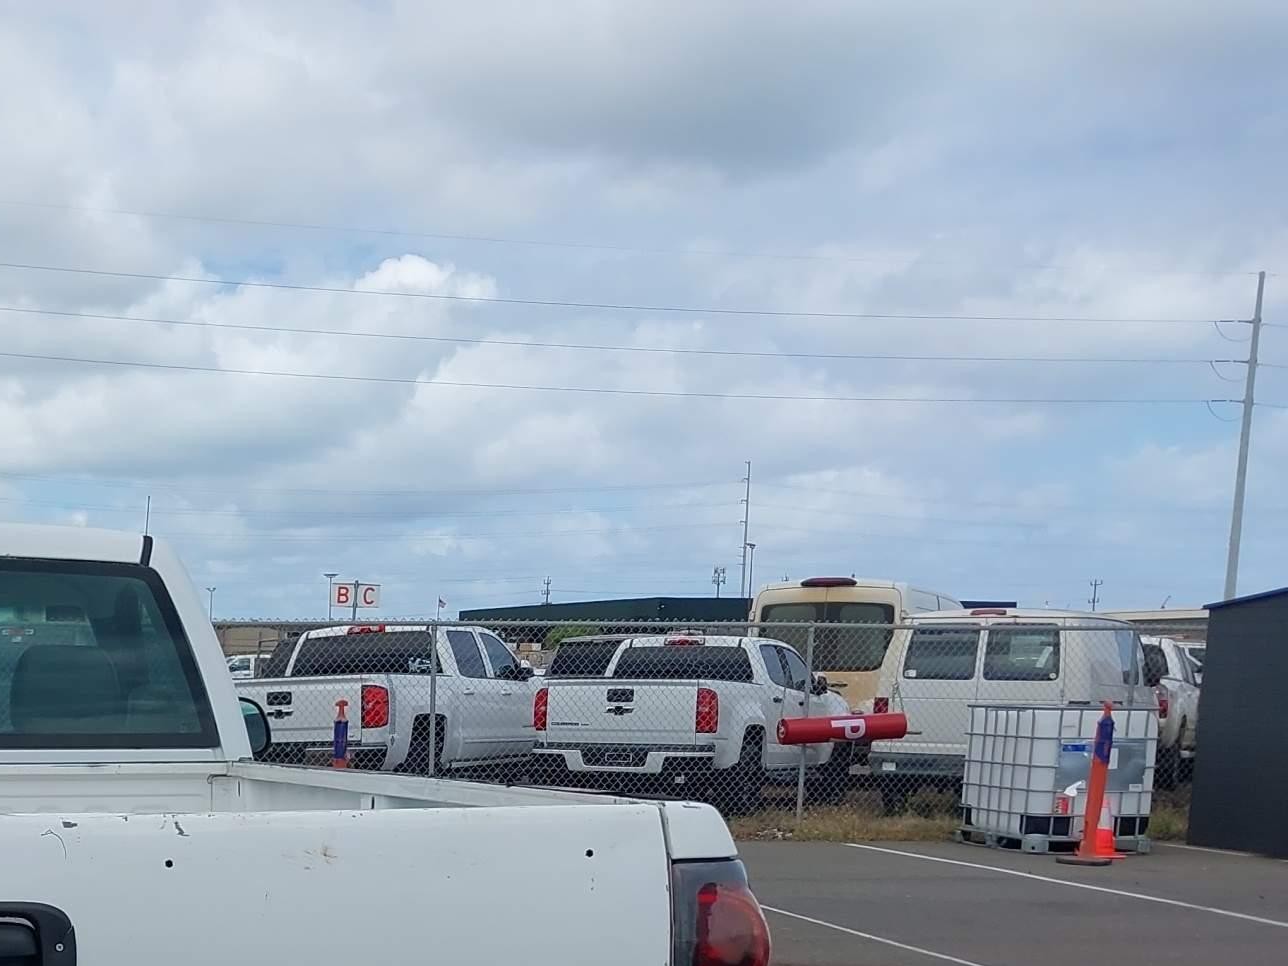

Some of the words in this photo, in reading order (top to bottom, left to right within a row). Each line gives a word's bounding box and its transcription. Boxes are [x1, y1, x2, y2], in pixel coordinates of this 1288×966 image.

[337, 586, 350, 604] B
[363, 587, 375, 605] C
[830, 718, 866, 739] P
